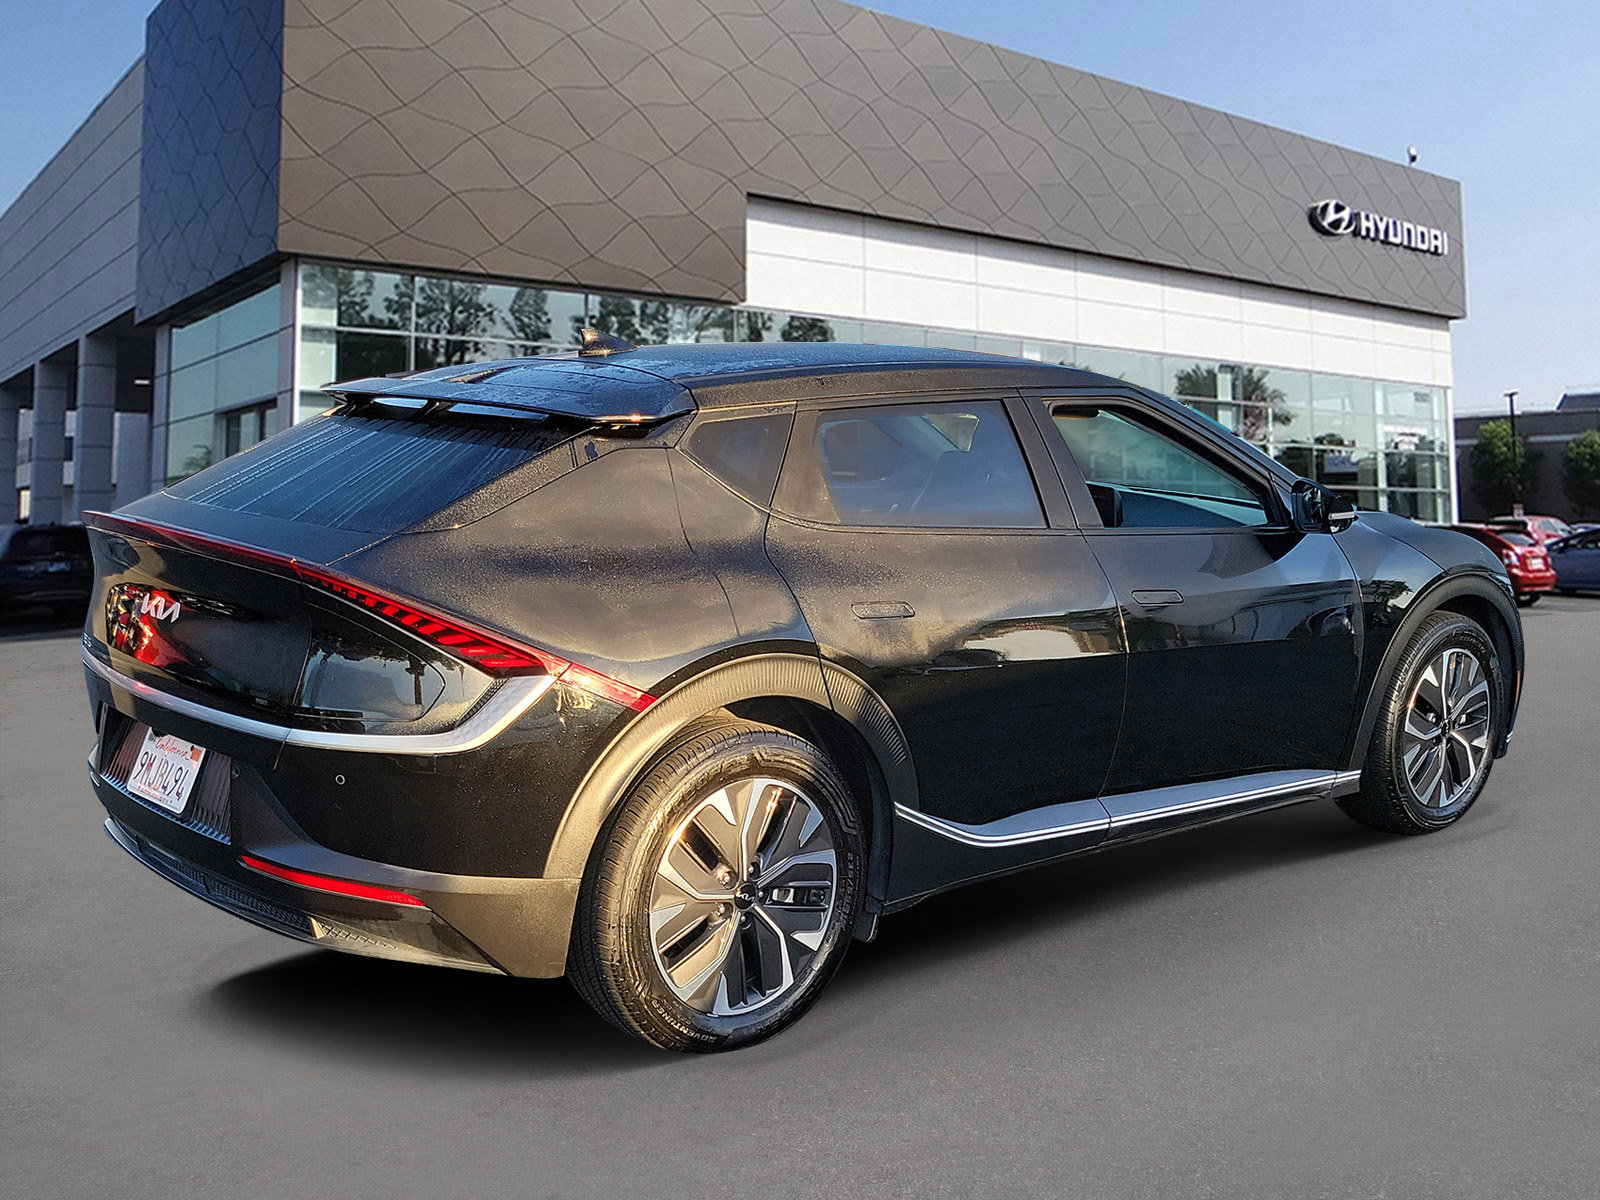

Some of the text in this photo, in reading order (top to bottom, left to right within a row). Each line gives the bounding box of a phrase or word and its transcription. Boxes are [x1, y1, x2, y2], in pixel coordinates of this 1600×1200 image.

[1360, 211, 1448, 255] HYUNDAI
[141, 592, 181, 623] KIA
[133, 751, 189, 801] 9MJB494
